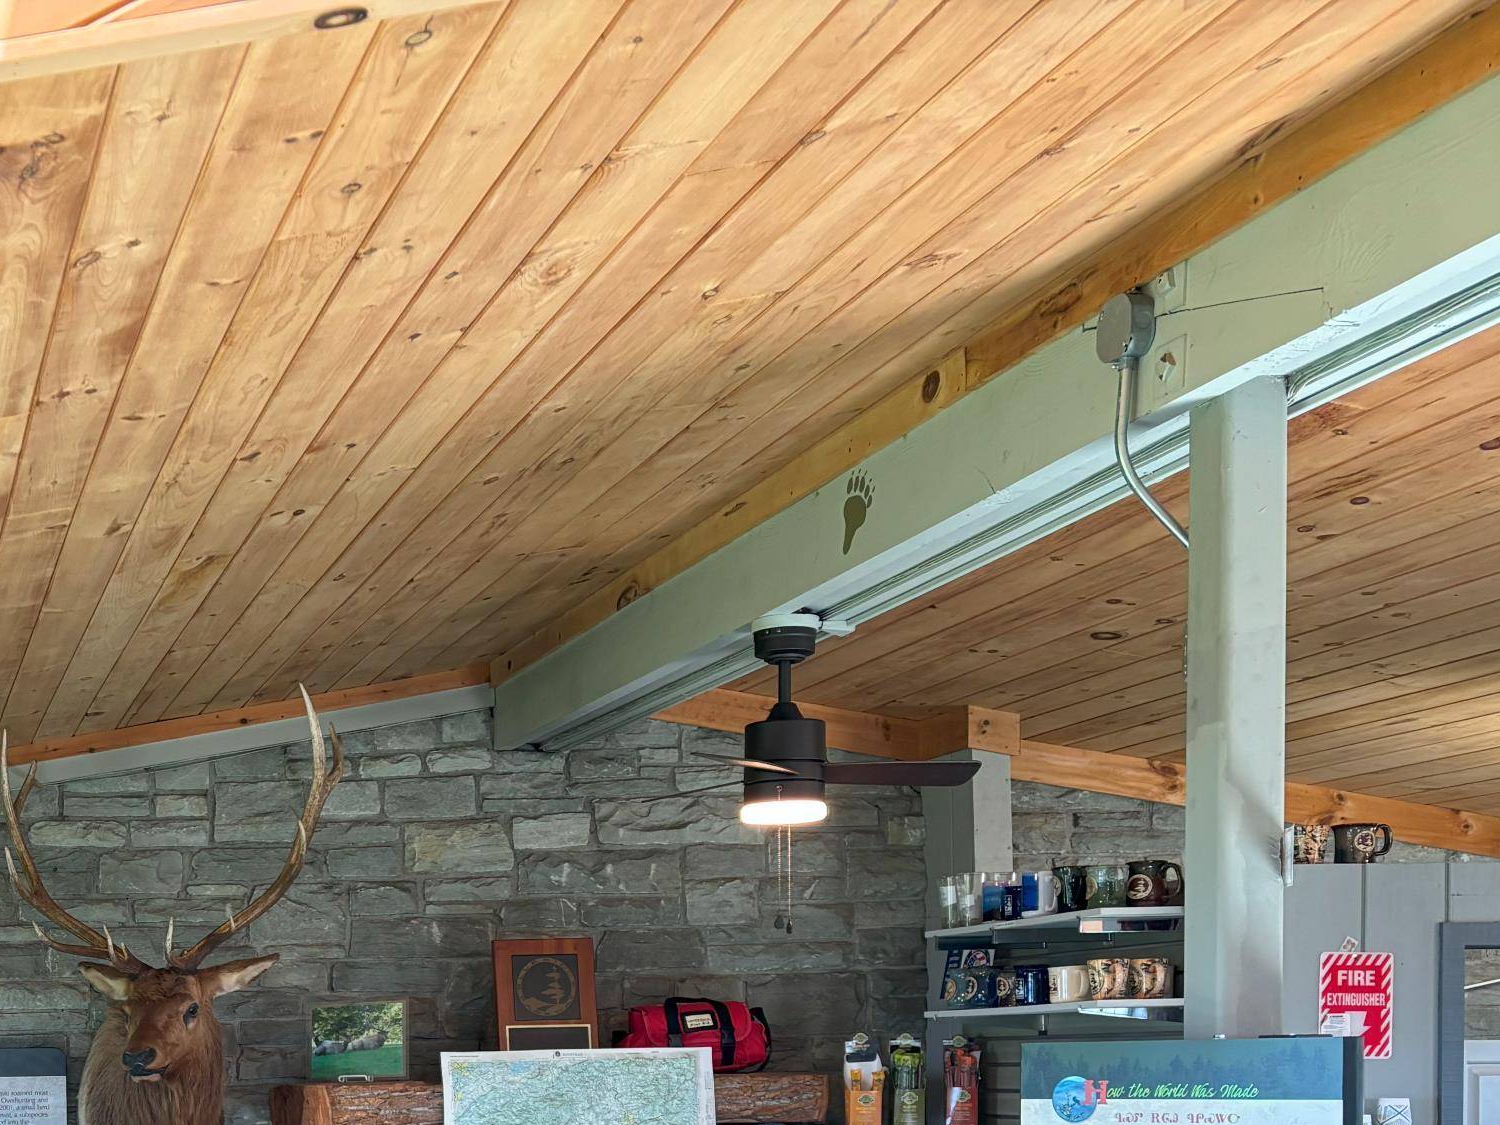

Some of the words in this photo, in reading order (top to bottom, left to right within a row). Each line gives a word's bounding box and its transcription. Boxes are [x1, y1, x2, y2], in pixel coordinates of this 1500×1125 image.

[1338, 970, 1375, 986] FIRE
[1327, 994, 1385, 1006] EXTINGUISHER
[1082, 1079, 1125, 1105] How
[1129, 1083, 1149, 1098] the
[1155, 1083, 1188, 1098] World
[1191, 1083, 1216, 1098] Was
[1220, 1083, 1259, 1098] Made
